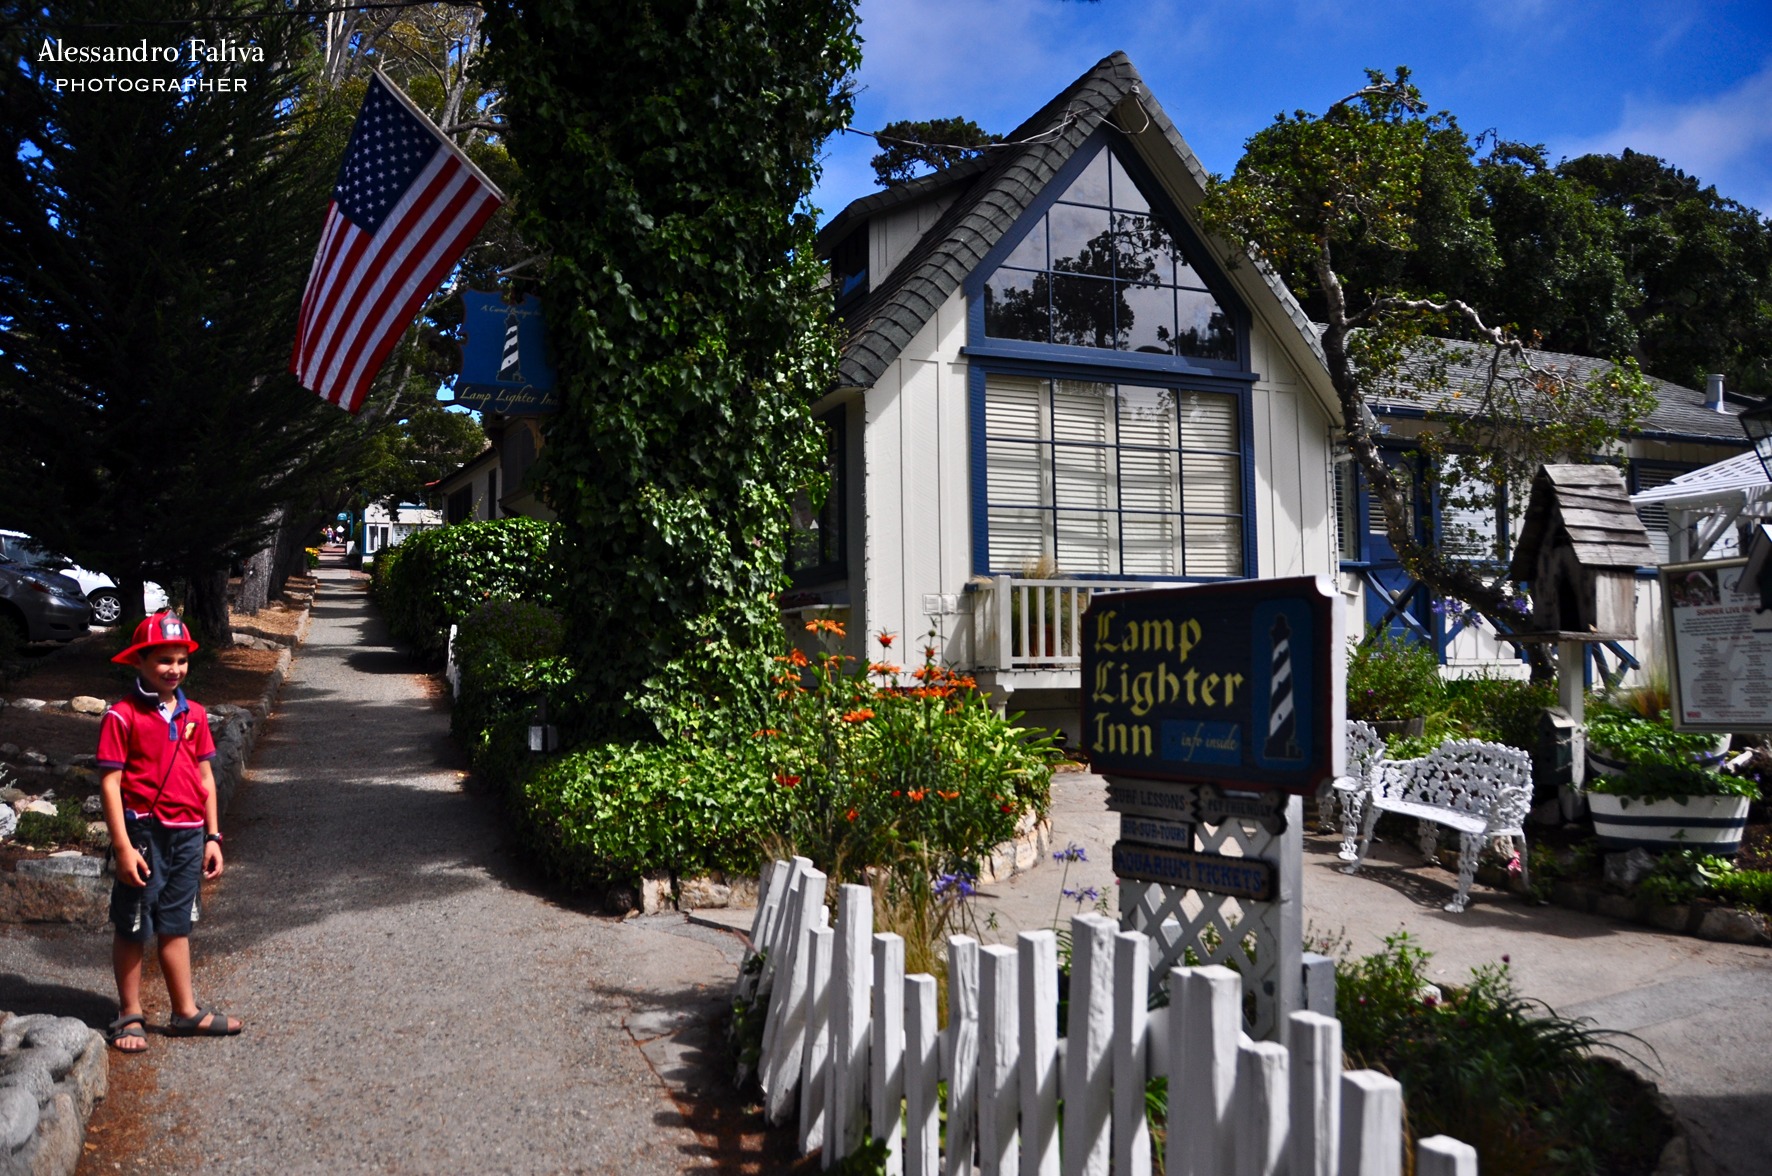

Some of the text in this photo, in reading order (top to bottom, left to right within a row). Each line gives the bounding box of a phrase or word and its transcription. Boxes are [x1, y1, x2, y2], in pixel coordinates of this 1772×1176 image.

[459, 384, 559, 414] Lamp Lighter Inn
[1093, 610, 1202, 663] Lamp
[1092, 661, 1244, 716] Lighter
[1092, 712, 1153, 757] Inn
[1205, 723, 1240, 752] inside
[1113, 787, 1186, 811] SURF LESSONS
[1159, 825, 1187, 843] TOURS
[1117, 850, 1262, 893] AQUARIUM TICKETS
